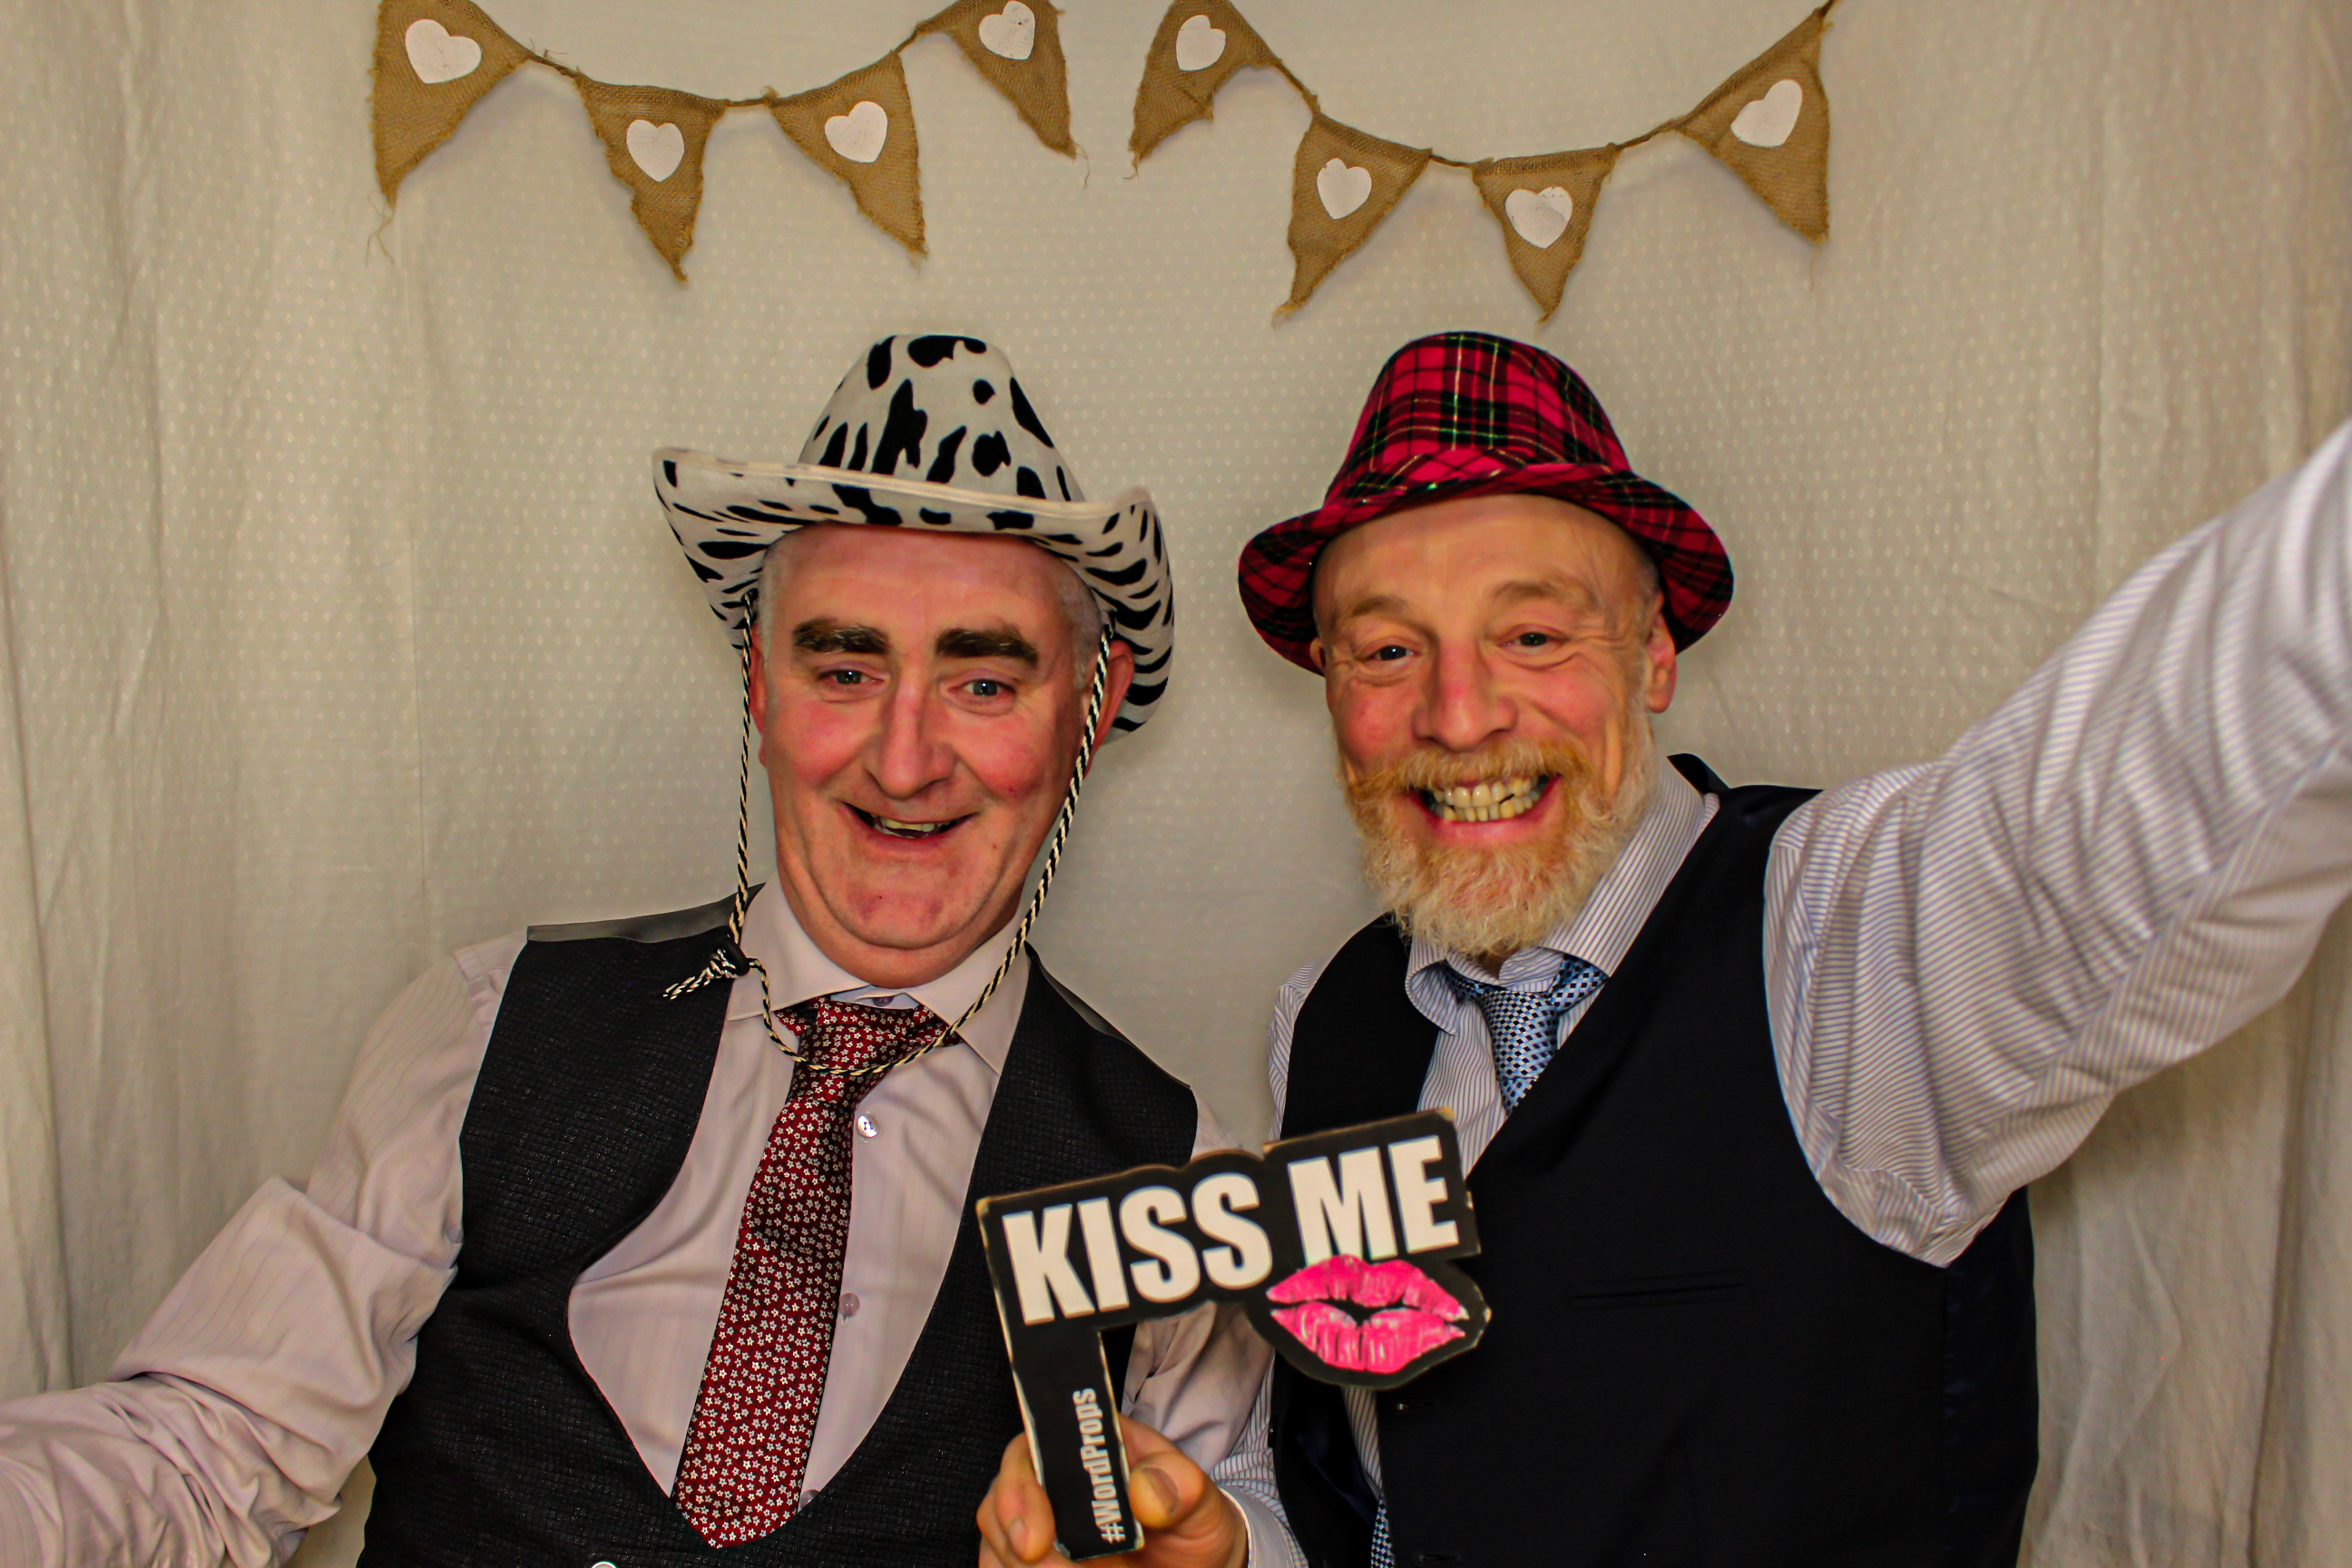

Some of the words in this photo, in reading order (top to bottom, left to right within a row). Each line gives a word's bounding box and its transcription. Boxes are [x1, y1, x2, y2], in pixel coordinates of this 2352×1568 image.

[1002, 1172, 1273, 1326] KISS
[1287, 1135, 1459, 1263] ME
[1073, 1387, 1126, 1544] #WordProps
